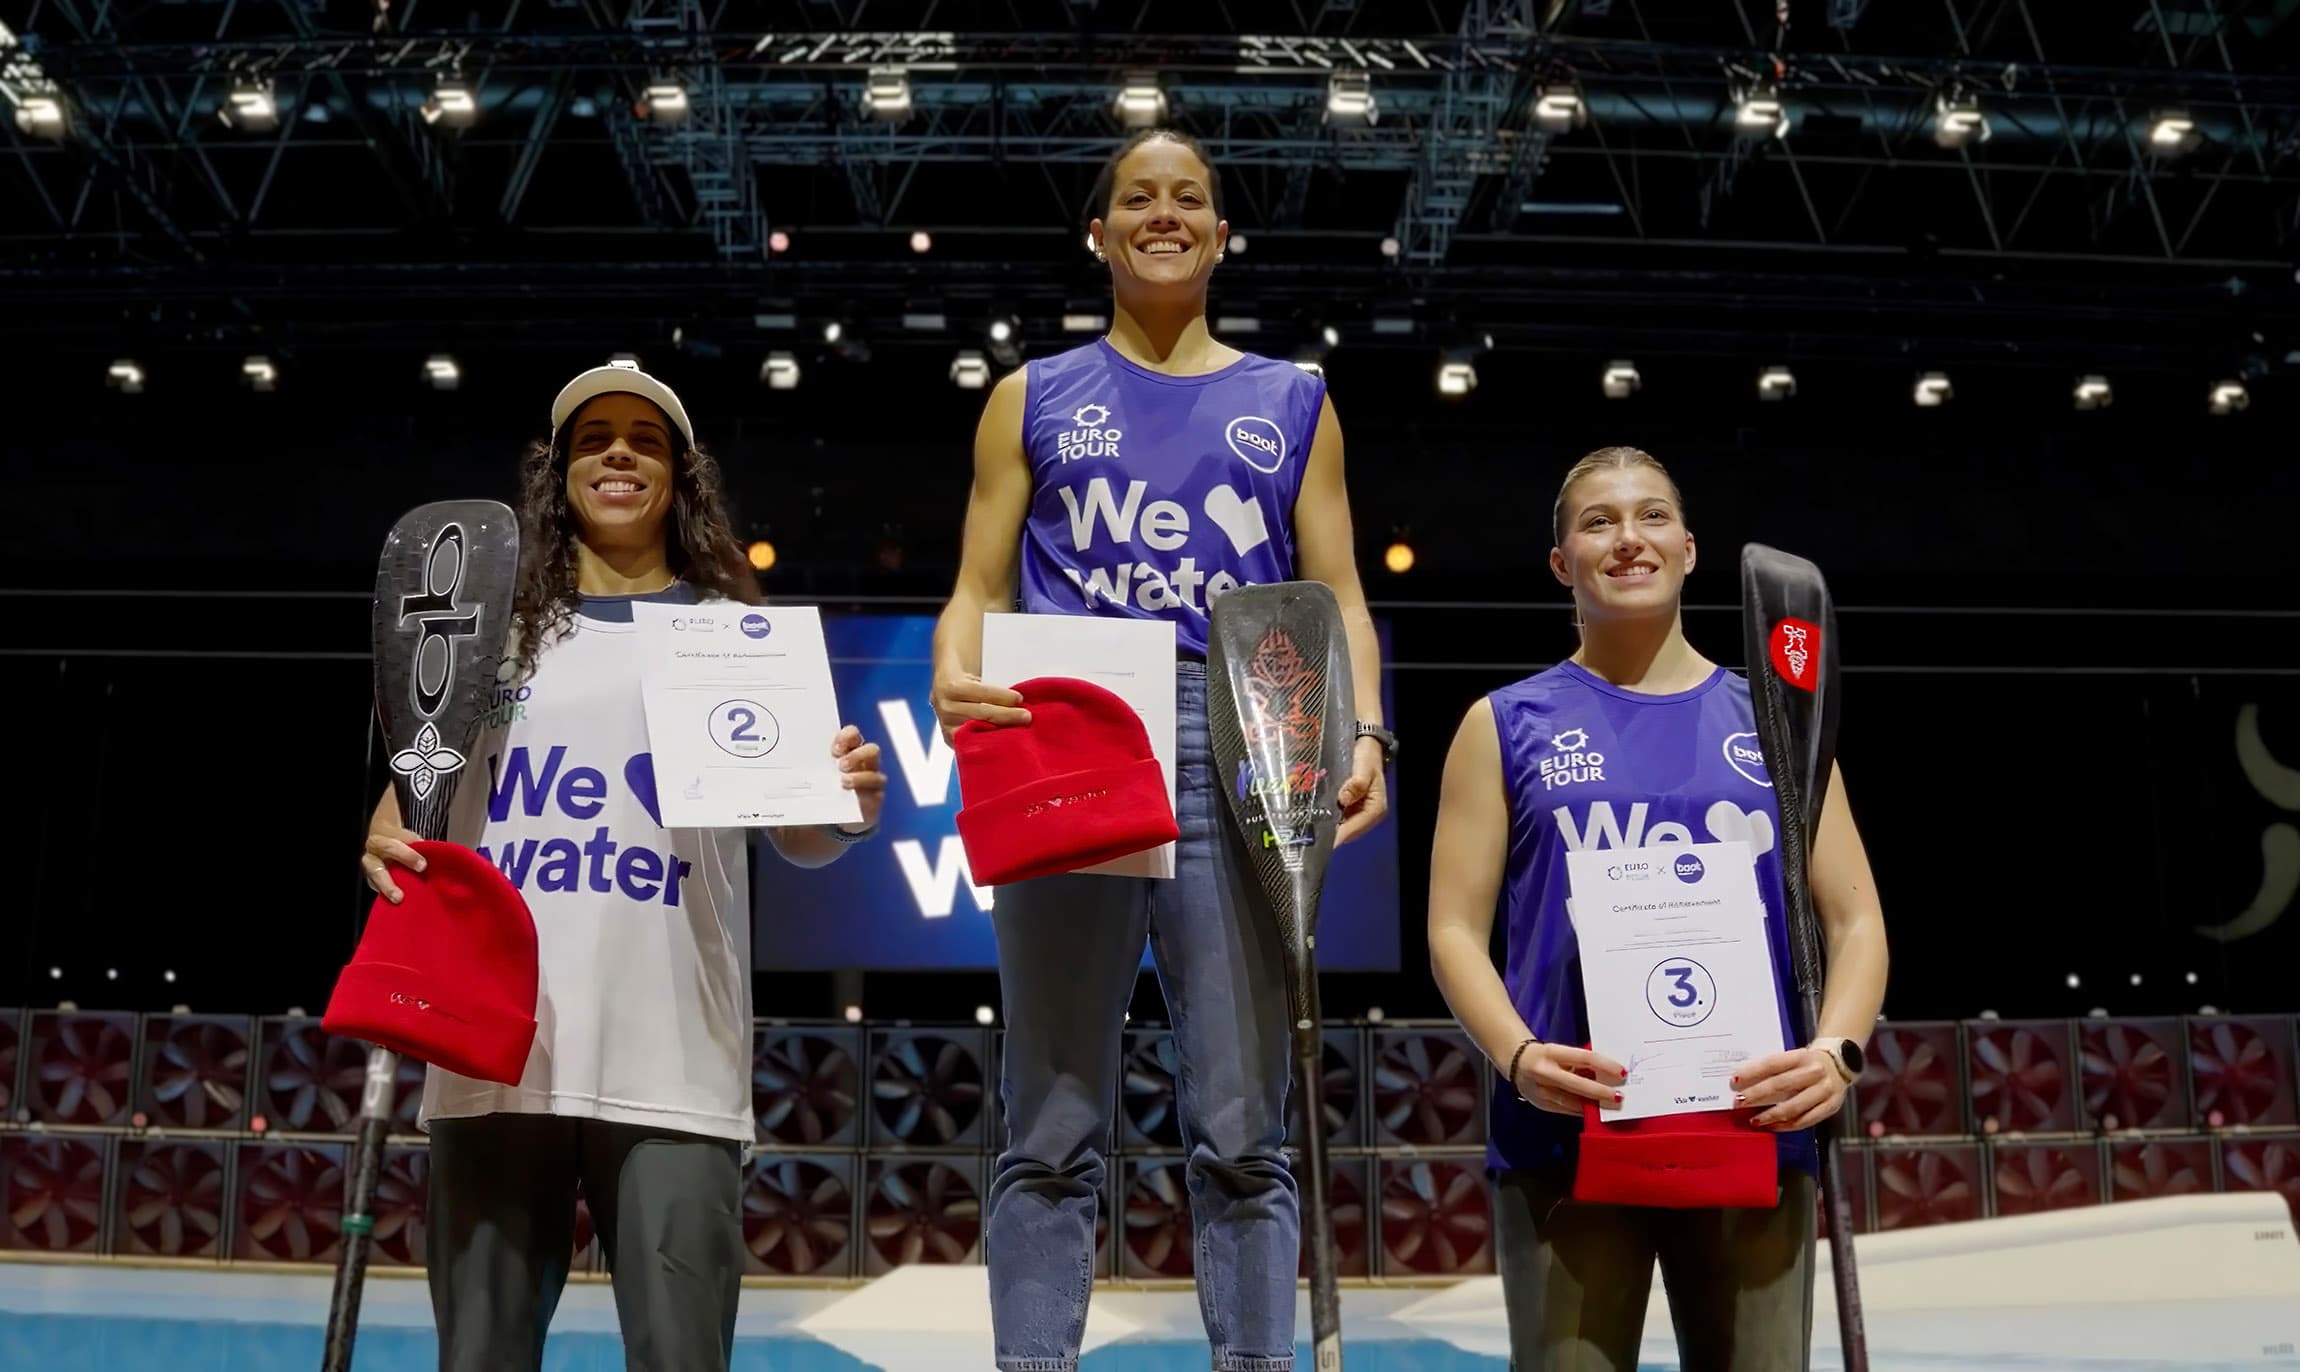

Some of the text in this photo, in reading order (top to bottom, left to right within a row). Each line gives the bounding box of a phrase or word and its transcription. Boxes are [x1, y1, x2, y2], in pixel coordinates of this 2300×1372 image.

[1057, 442, 1121, 464] TOUR
[1058, 428, 1122, 449] EURO
[1236, 427, 1279, 456] boot
[1058, 477, 1190, 552] We
[1063, 557, 1256, 616] wate
[489, 686, 531, 710] URO
[727, 707, 767, 742] 2.
[1540, 752, 1605, 776] EURO
[1542, 766, 1606, 790] TOUR
[488, 745, 607, 823] We
[477, 826, 692, 907] water
[1664, 966, 1704, 1008] 3.
